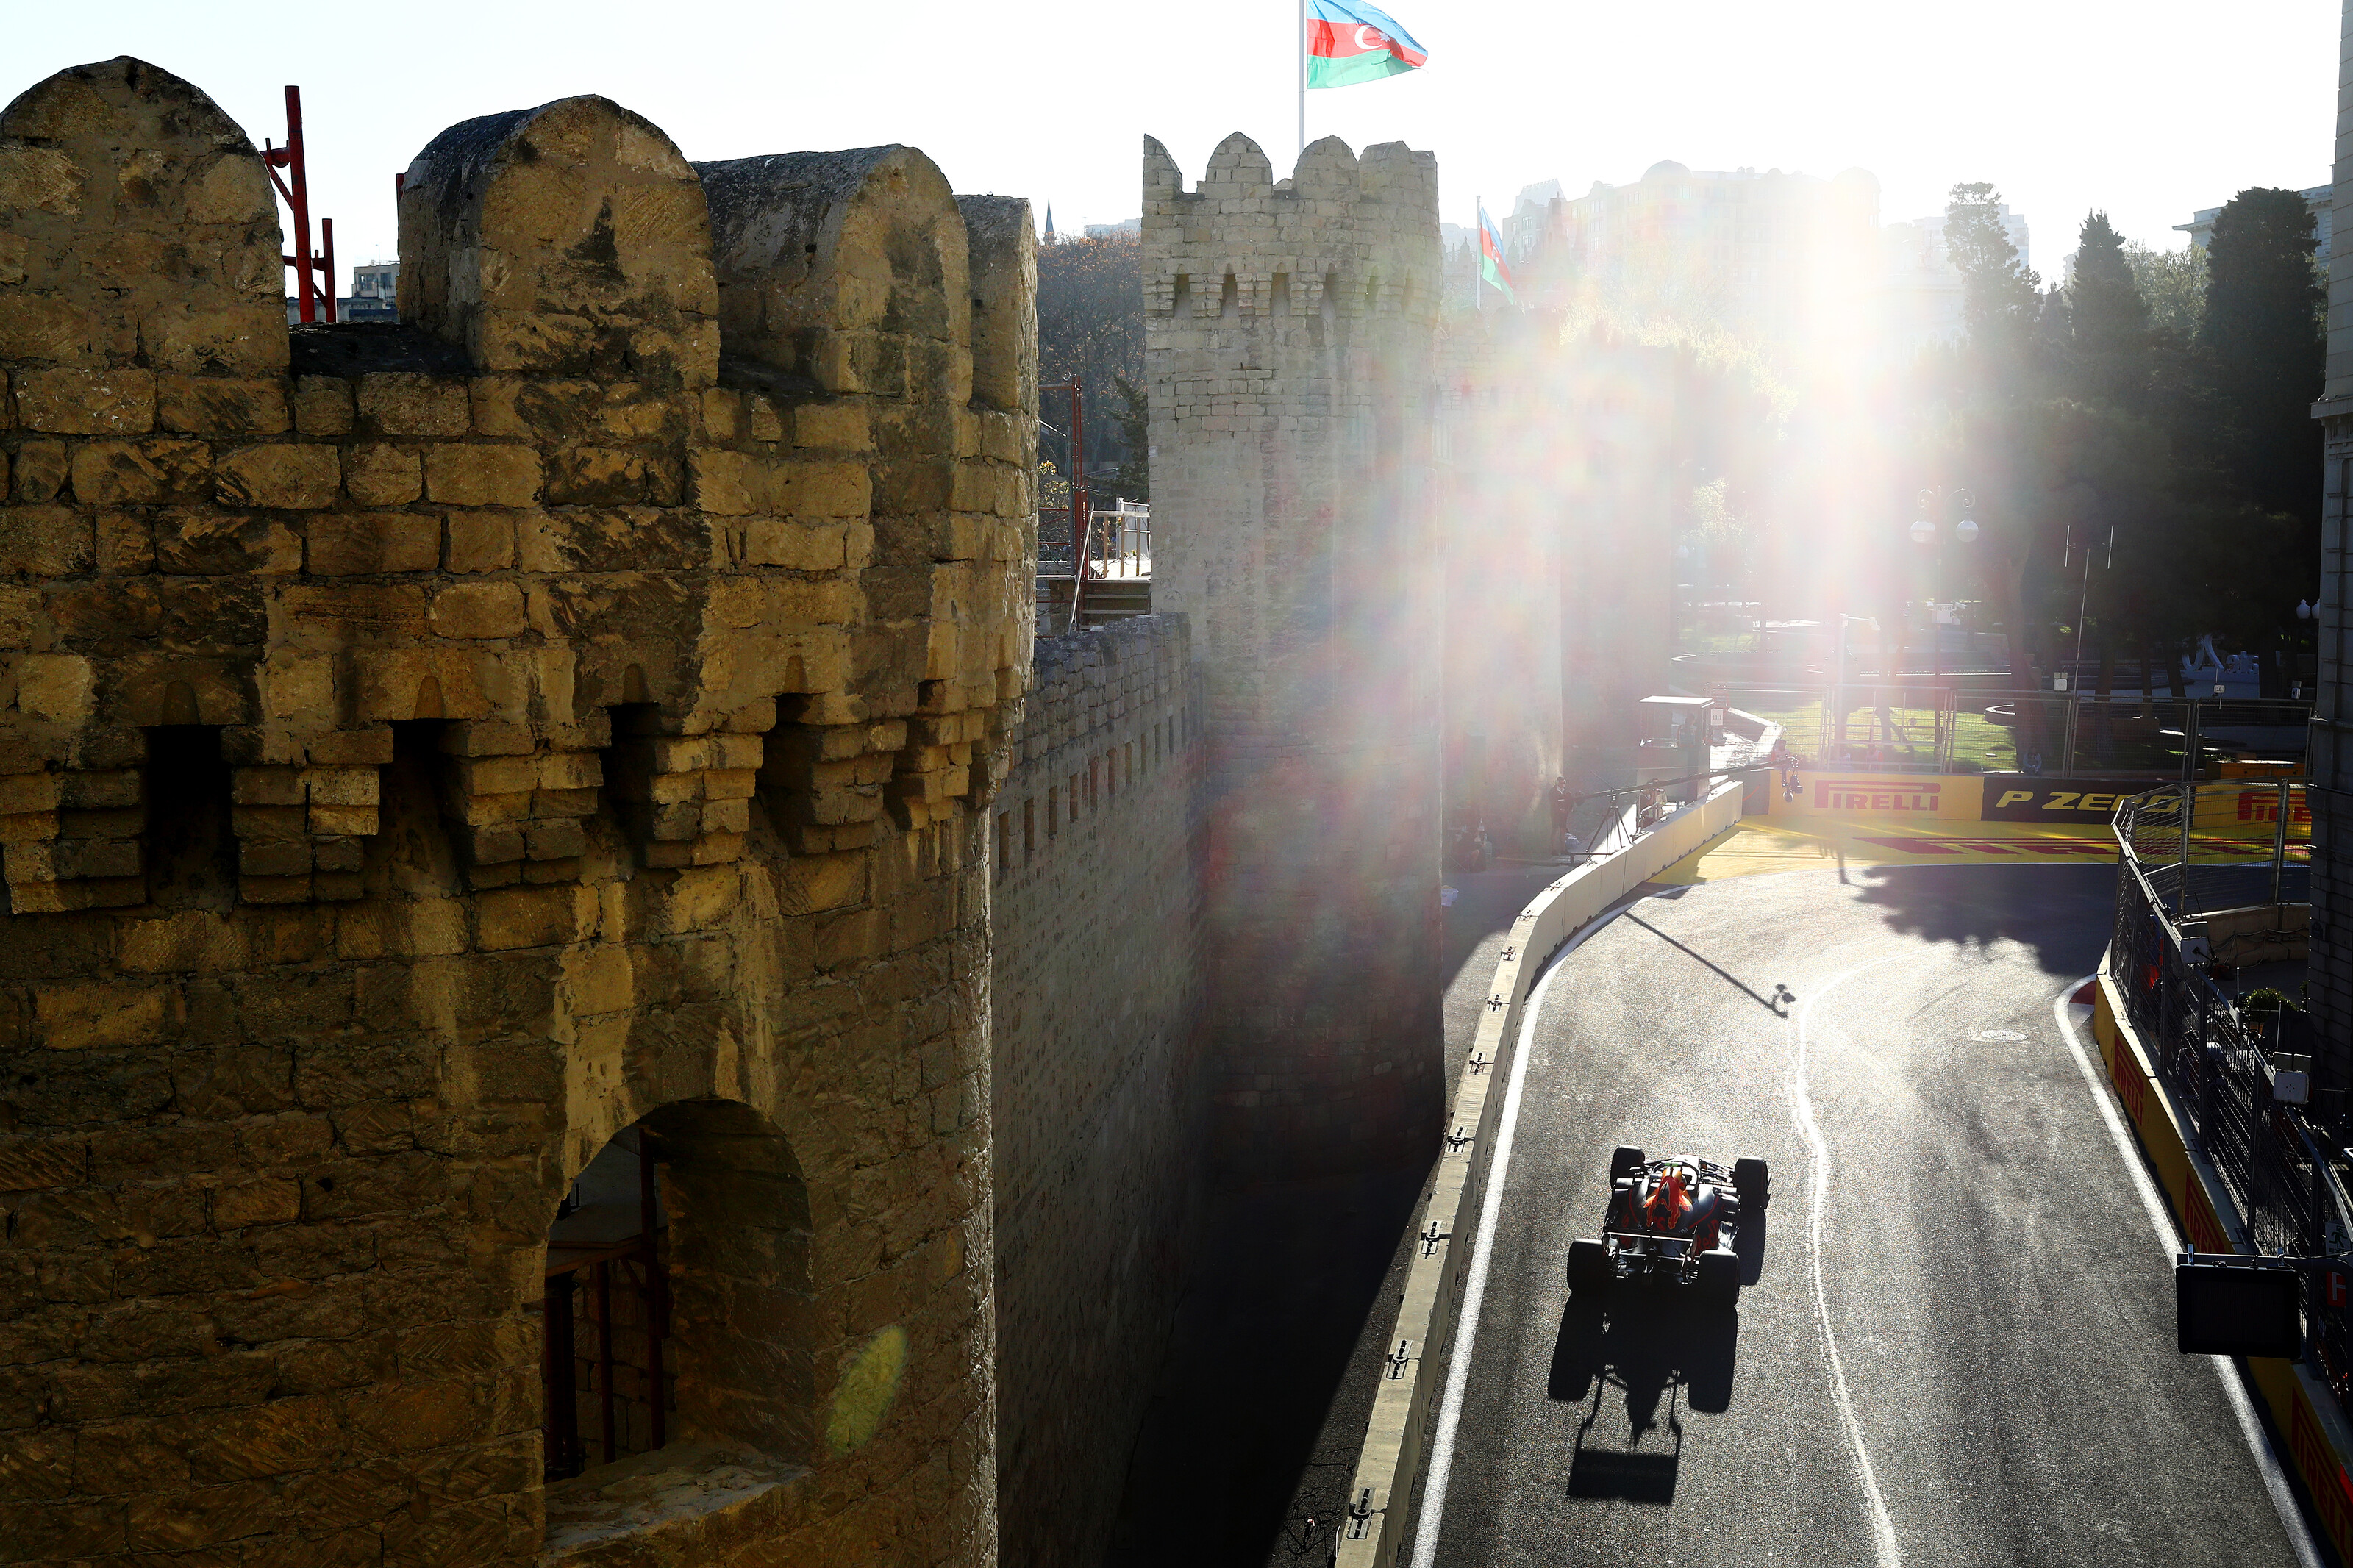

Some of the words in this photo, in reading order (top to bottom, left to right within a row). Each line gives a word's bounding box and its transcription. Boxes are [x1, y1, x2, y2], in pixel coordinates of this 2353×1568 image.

[1814, 780, 1940, 811] PIRELLI
[1996, 791, 2034, 808] P
[2114, 1034, 2144, 1126] PIRELLI
